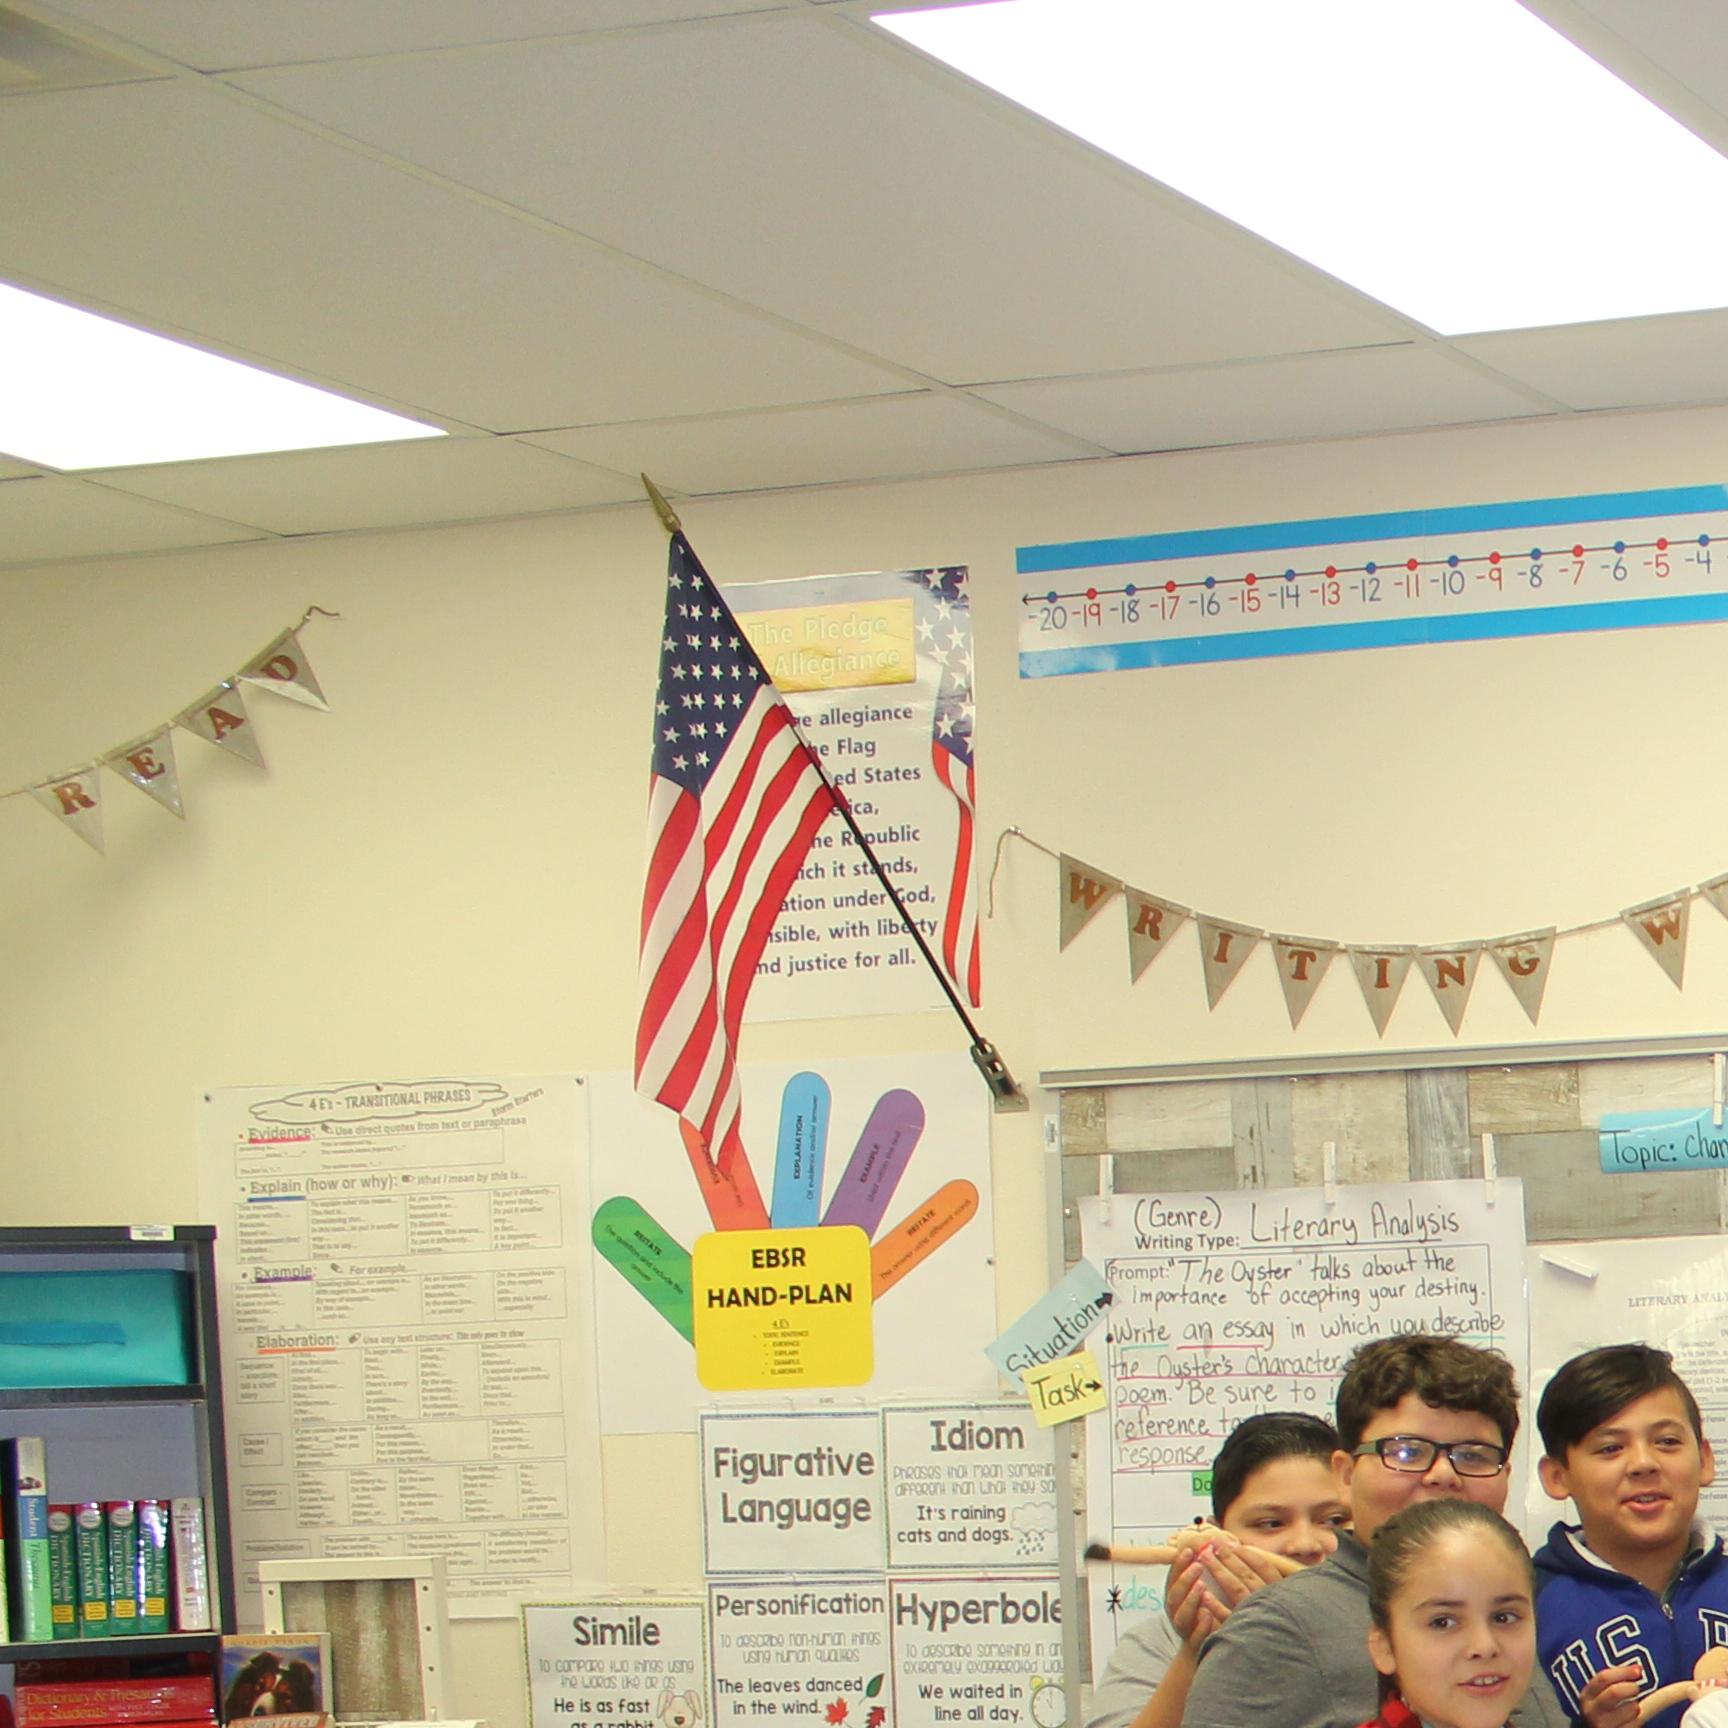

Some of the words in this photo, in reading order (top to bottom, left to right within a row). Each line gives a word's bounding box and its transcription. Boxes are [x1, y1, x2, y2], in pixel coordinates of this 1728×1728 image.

[1029, 605, 1067, 630] -20
[1350, 577, 1381, 602] -12
[1685, 550, 1711, 573] -4
[803, 617, 888, 643] Pledge
[774, 650, 900, 680] Allegiance
[820, 705, 912, 727] allegiance
[837, 738, 876, 757] Flag
[864, 767, 921, 783] States
[834, 890, 886, 908] under
[829, 921, 869, 939] with
[1069, 872, 1539, 989] WRITING
[787, 954, 847, 977] justice
[855, 951, 880, 967] for
[888, 948, 915, 965] all.
[344, 1091, 421, 1109] TRANSITIONAL
[424, 1088, 470, 1105] PHRASES
[248, 1124, 315, 1142] Evidence:
[1600, 1130, 1678, 1170] Topic:
[250, 1178, 302, 1195] Explain
[1134, 1197, 1223, 1234] (Genre)
[1249, 1203, 1359, 1244] Literary
[1371, 1201, 1460, 1240] Analysis
[1134, 1233, 1193, 1249] Writing
[1198, 1233, 1240, 1251] Type:
[752, 1247, 805, 1268] EBSR
[254, 1265, 316, 1282] Example:
[708, 1283, 852, 1308] HAND-PLAN
[1132, 1283, 1227, 1307] importance
[1280, 1280, 1360, 1307] accepting
[1415, 1273, 1486, 1307] destiny.
[256, 1332, 339, 1350] Elaboration:
[1005, 1301, 1099, 1371] Situation
[1113, 1321, 1171, 1343] Write
[1223, 1316, 1275, 1352] essay
[1431, 1312, 1504, 1333] describe
[1033, 1378, 1084, 1411] Task
[930, 1420, 1024, 1451] Idiom
[714, 1447, 874, 1484] Figurative
[722, 1493, 871, 1530] Language
[951, 1505, 1006, 1523] raining
[972, 1527, 1013, 1545] dogs.
[716, 1593, 884, 1616] Personification
[897, 1591, 1062, 1627] Hyperbole
[573, 1616, 660, 1646] Simile
[749, 1679, 800, 1693] leaves
[806, 1677, 863, 1692] danced
[948, 1683, 1004, 1702] waited
